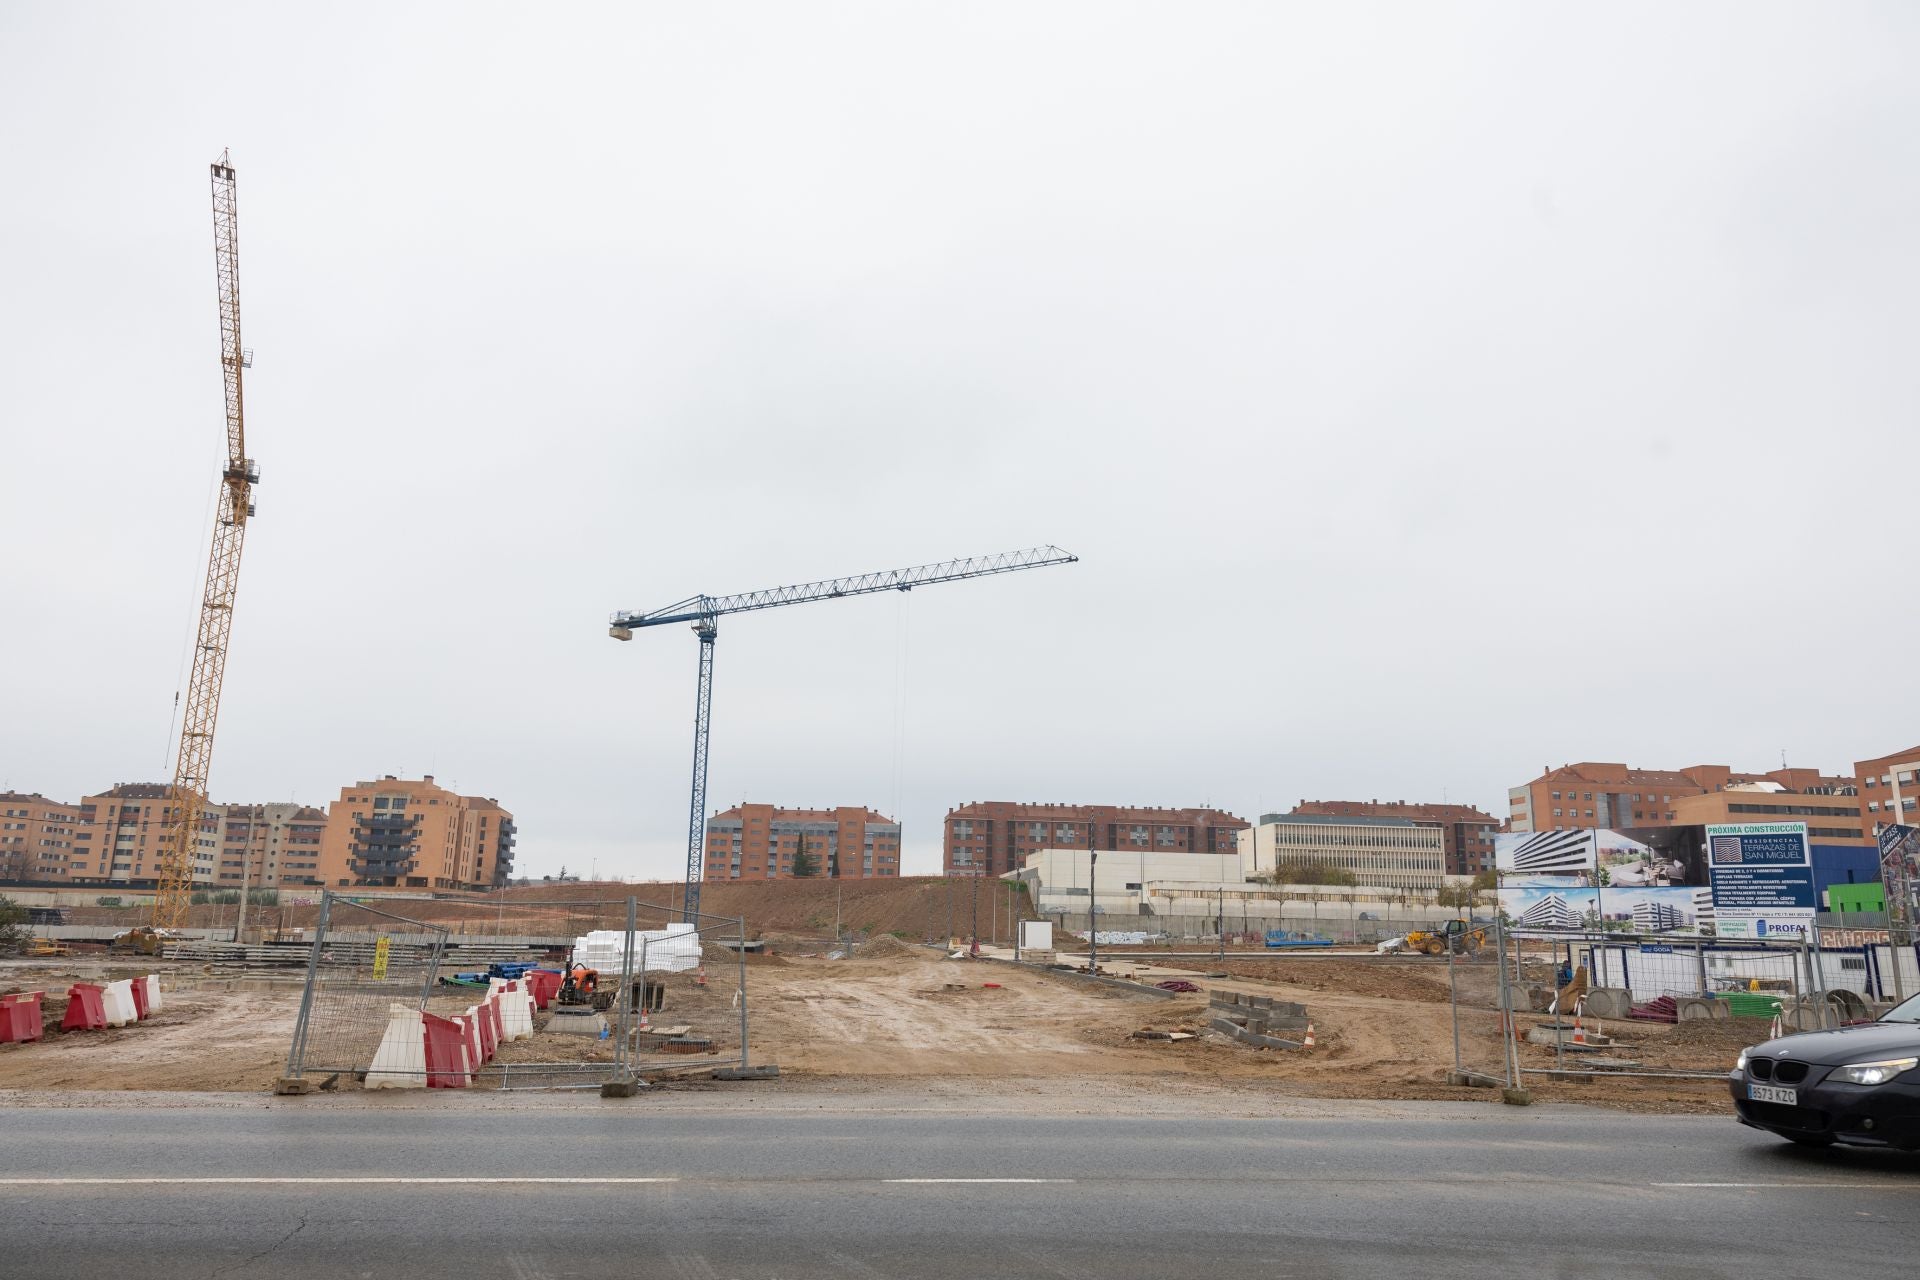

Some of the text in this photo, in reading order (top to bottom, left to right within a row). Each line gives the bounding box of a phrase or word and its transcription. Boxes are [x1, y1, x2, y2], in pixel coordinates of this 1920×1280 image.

[1708, 824, 1804, 834] PRÓXIMA CONSTRUCCIÓN
[1743, 844, 1786, 852] TERRAZAS
[1766, 851, 1802, 859] MIGUEL
[1769, 924, 1808, 932] PROFAL
[1776, 1090, 1794, 1102] KZC
